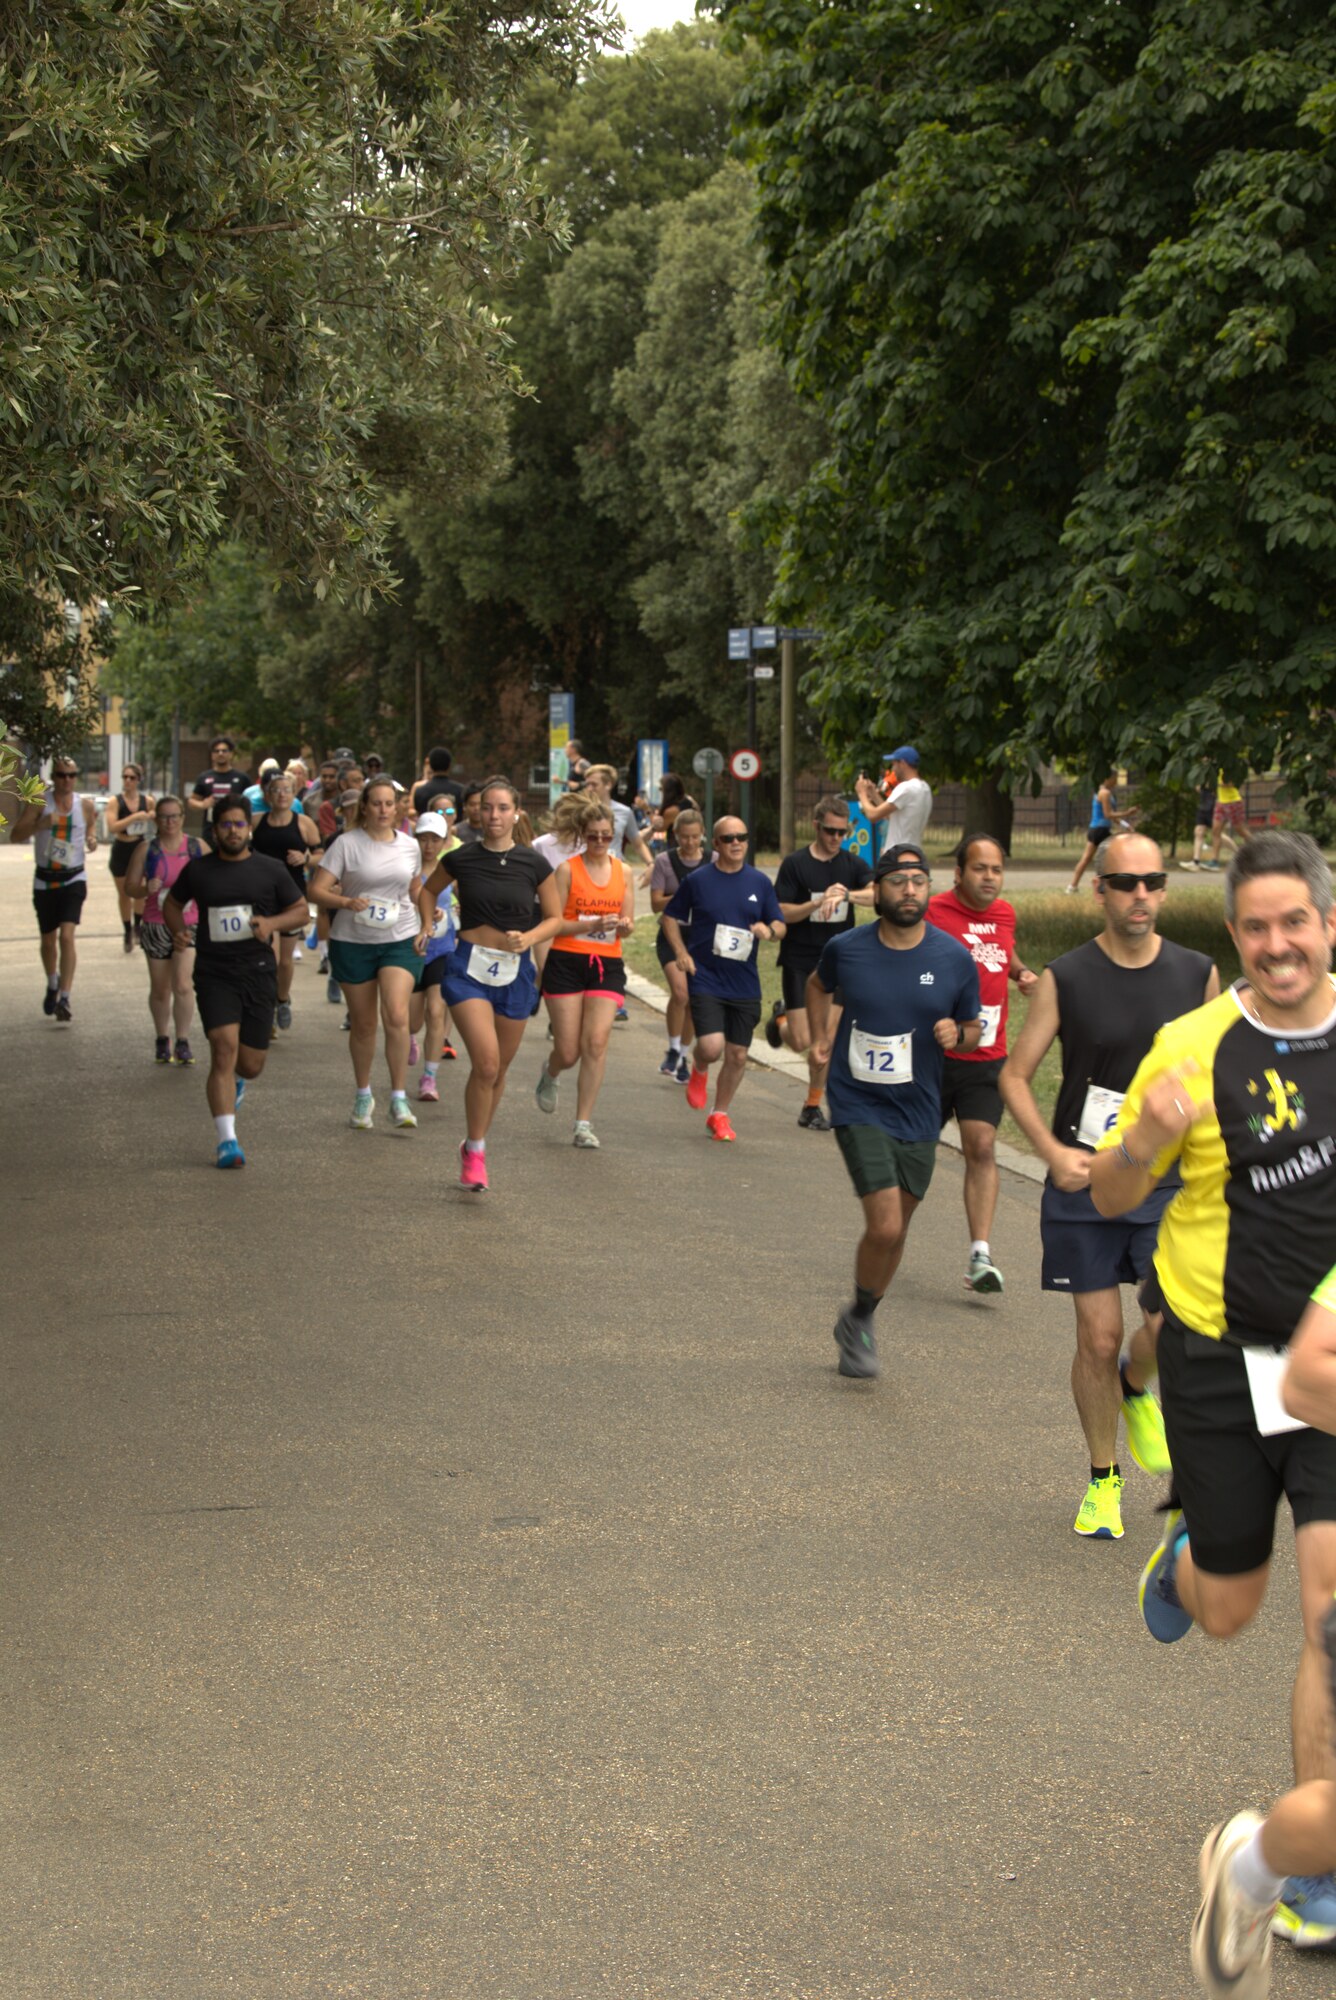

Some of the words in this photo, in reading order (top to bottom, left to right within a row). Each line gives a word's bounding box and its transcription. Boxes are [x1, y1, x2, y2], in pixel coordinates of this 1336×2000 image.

[741, 758, 750, 771] 5
[368, 904, 387, 921] 13
[220, 917, 241, 933] 10
[728, 937, 739, 951] 3
[487, 961, 499, 977] 4
[866, 1049, 894, 1072] 12
